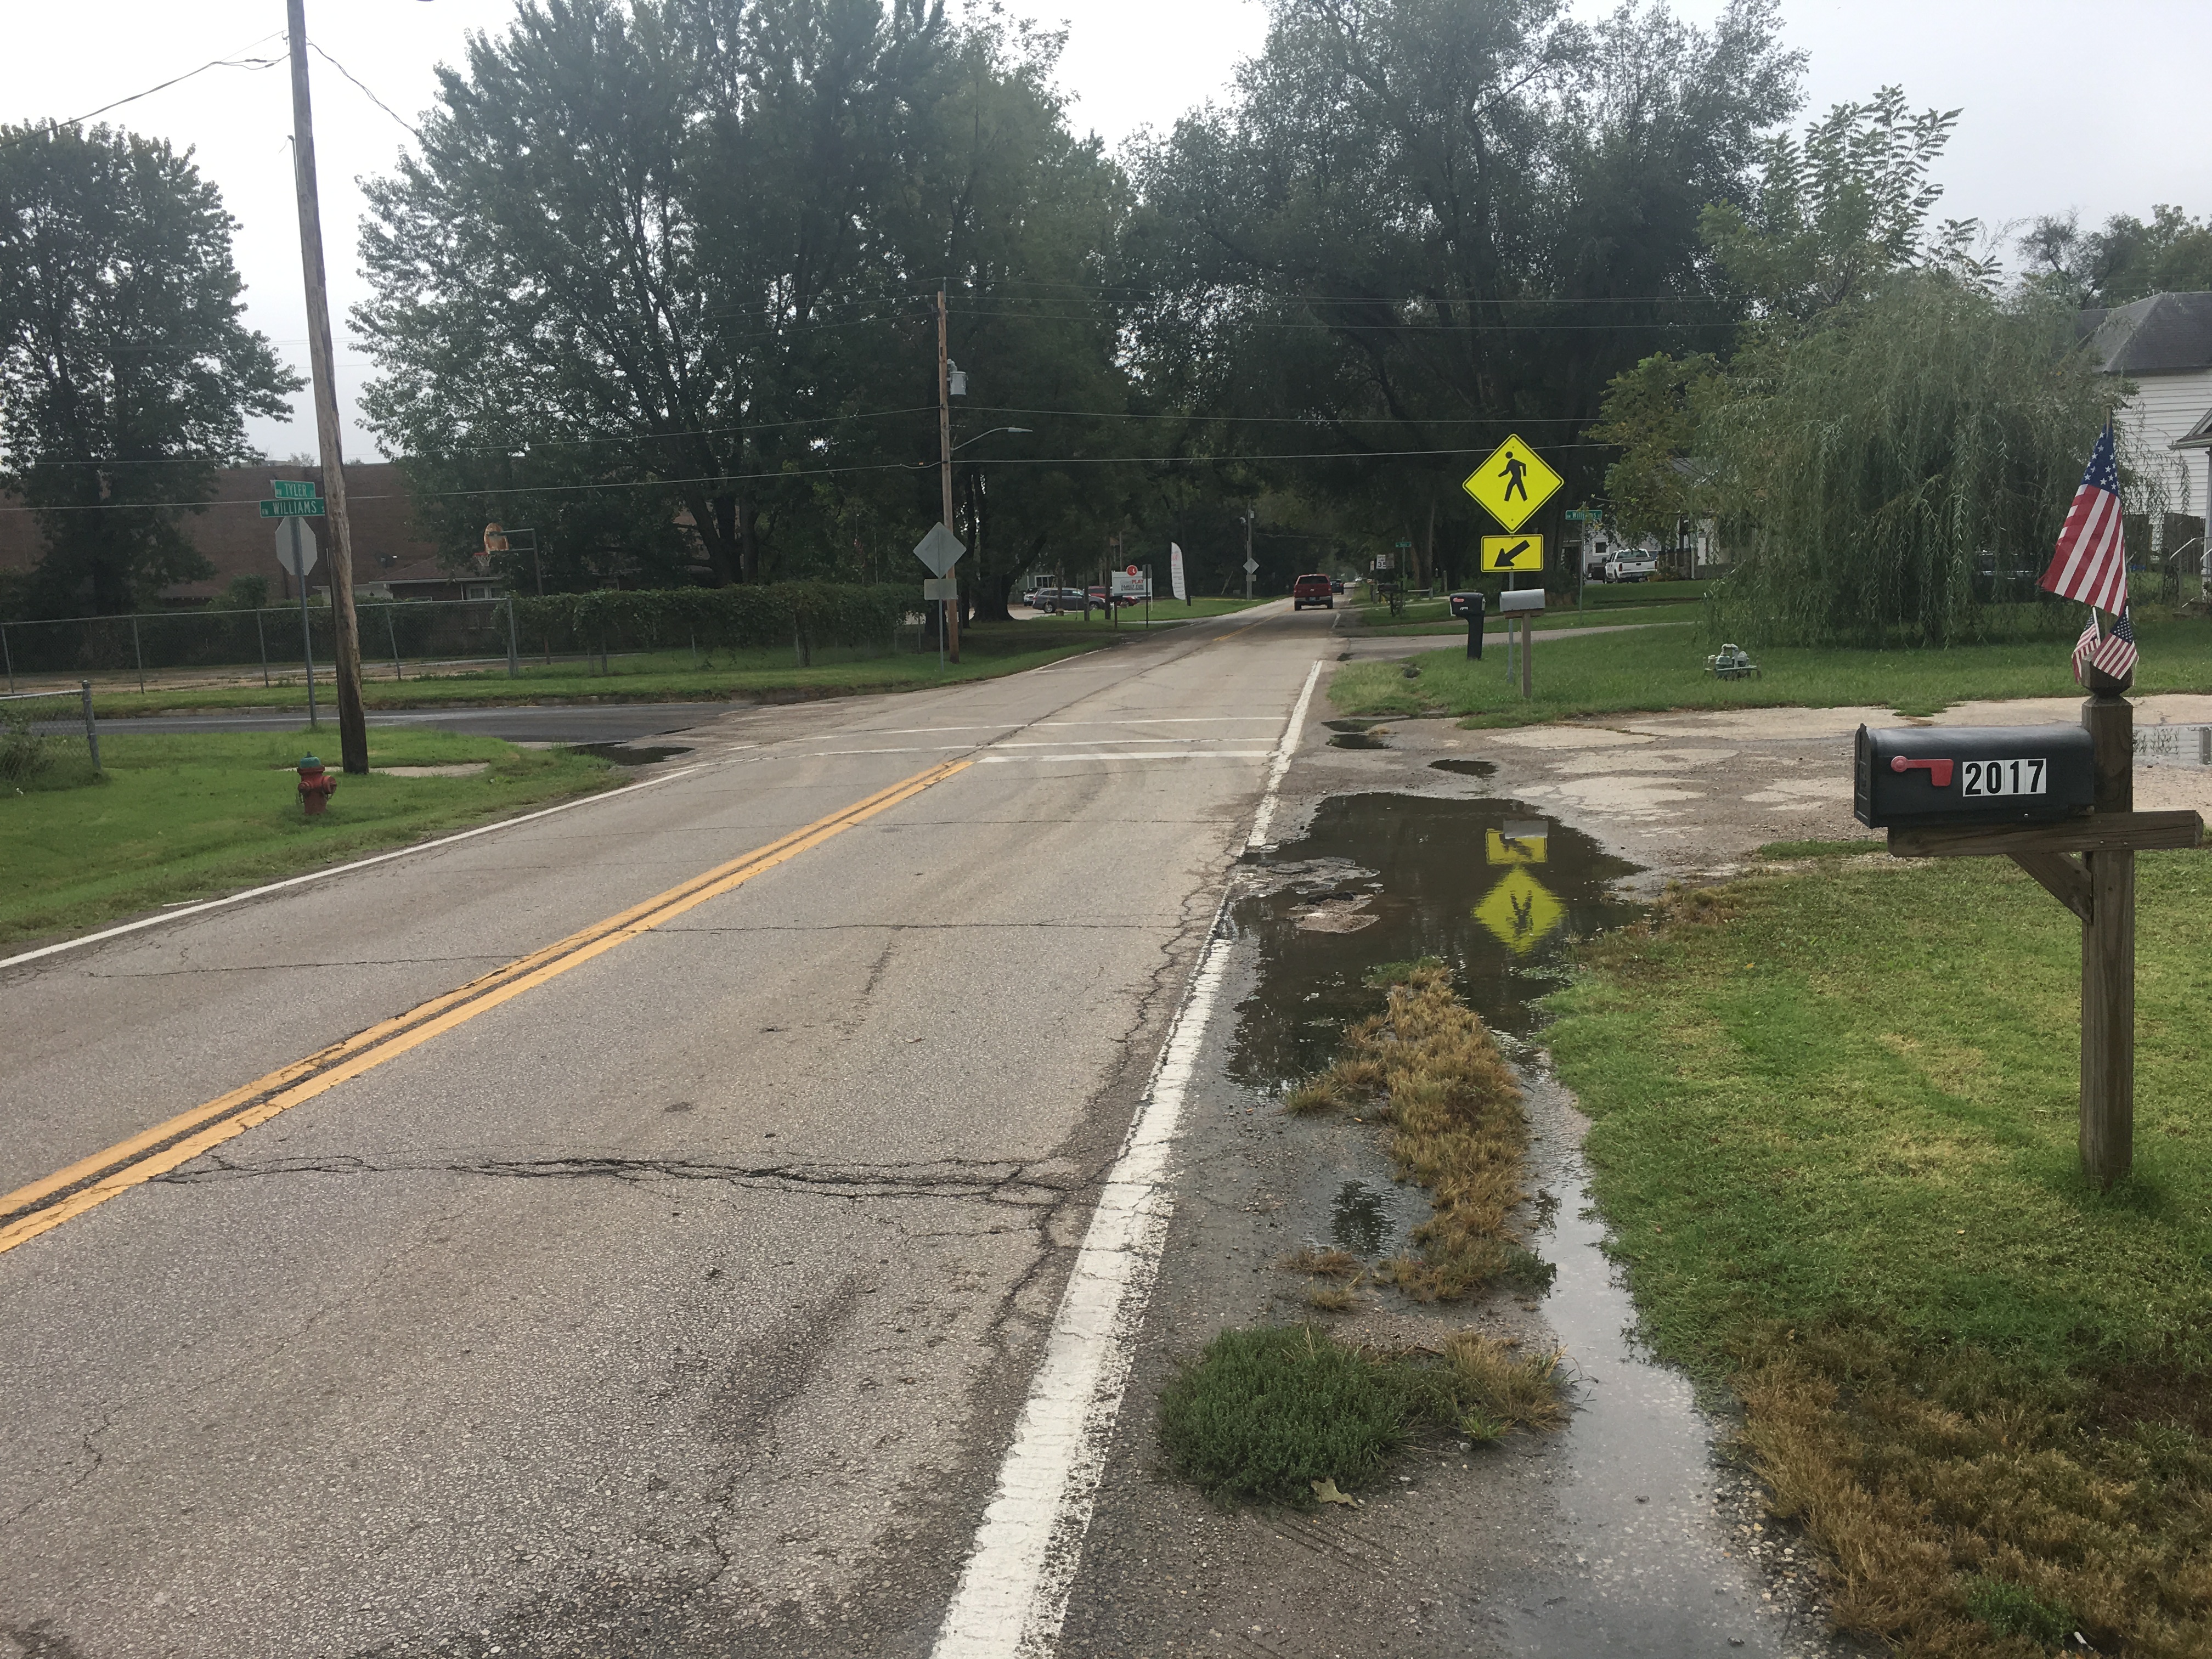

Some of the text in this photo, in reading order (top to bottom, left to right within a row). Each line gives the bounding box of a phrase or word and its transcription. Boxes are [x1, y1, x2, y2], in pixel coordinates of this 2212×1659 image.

[284, 483, 307, 497] TYLER
[273, 500, 317, 515] WILLIAMS
[1965, 759, 2044, 795] 2017
